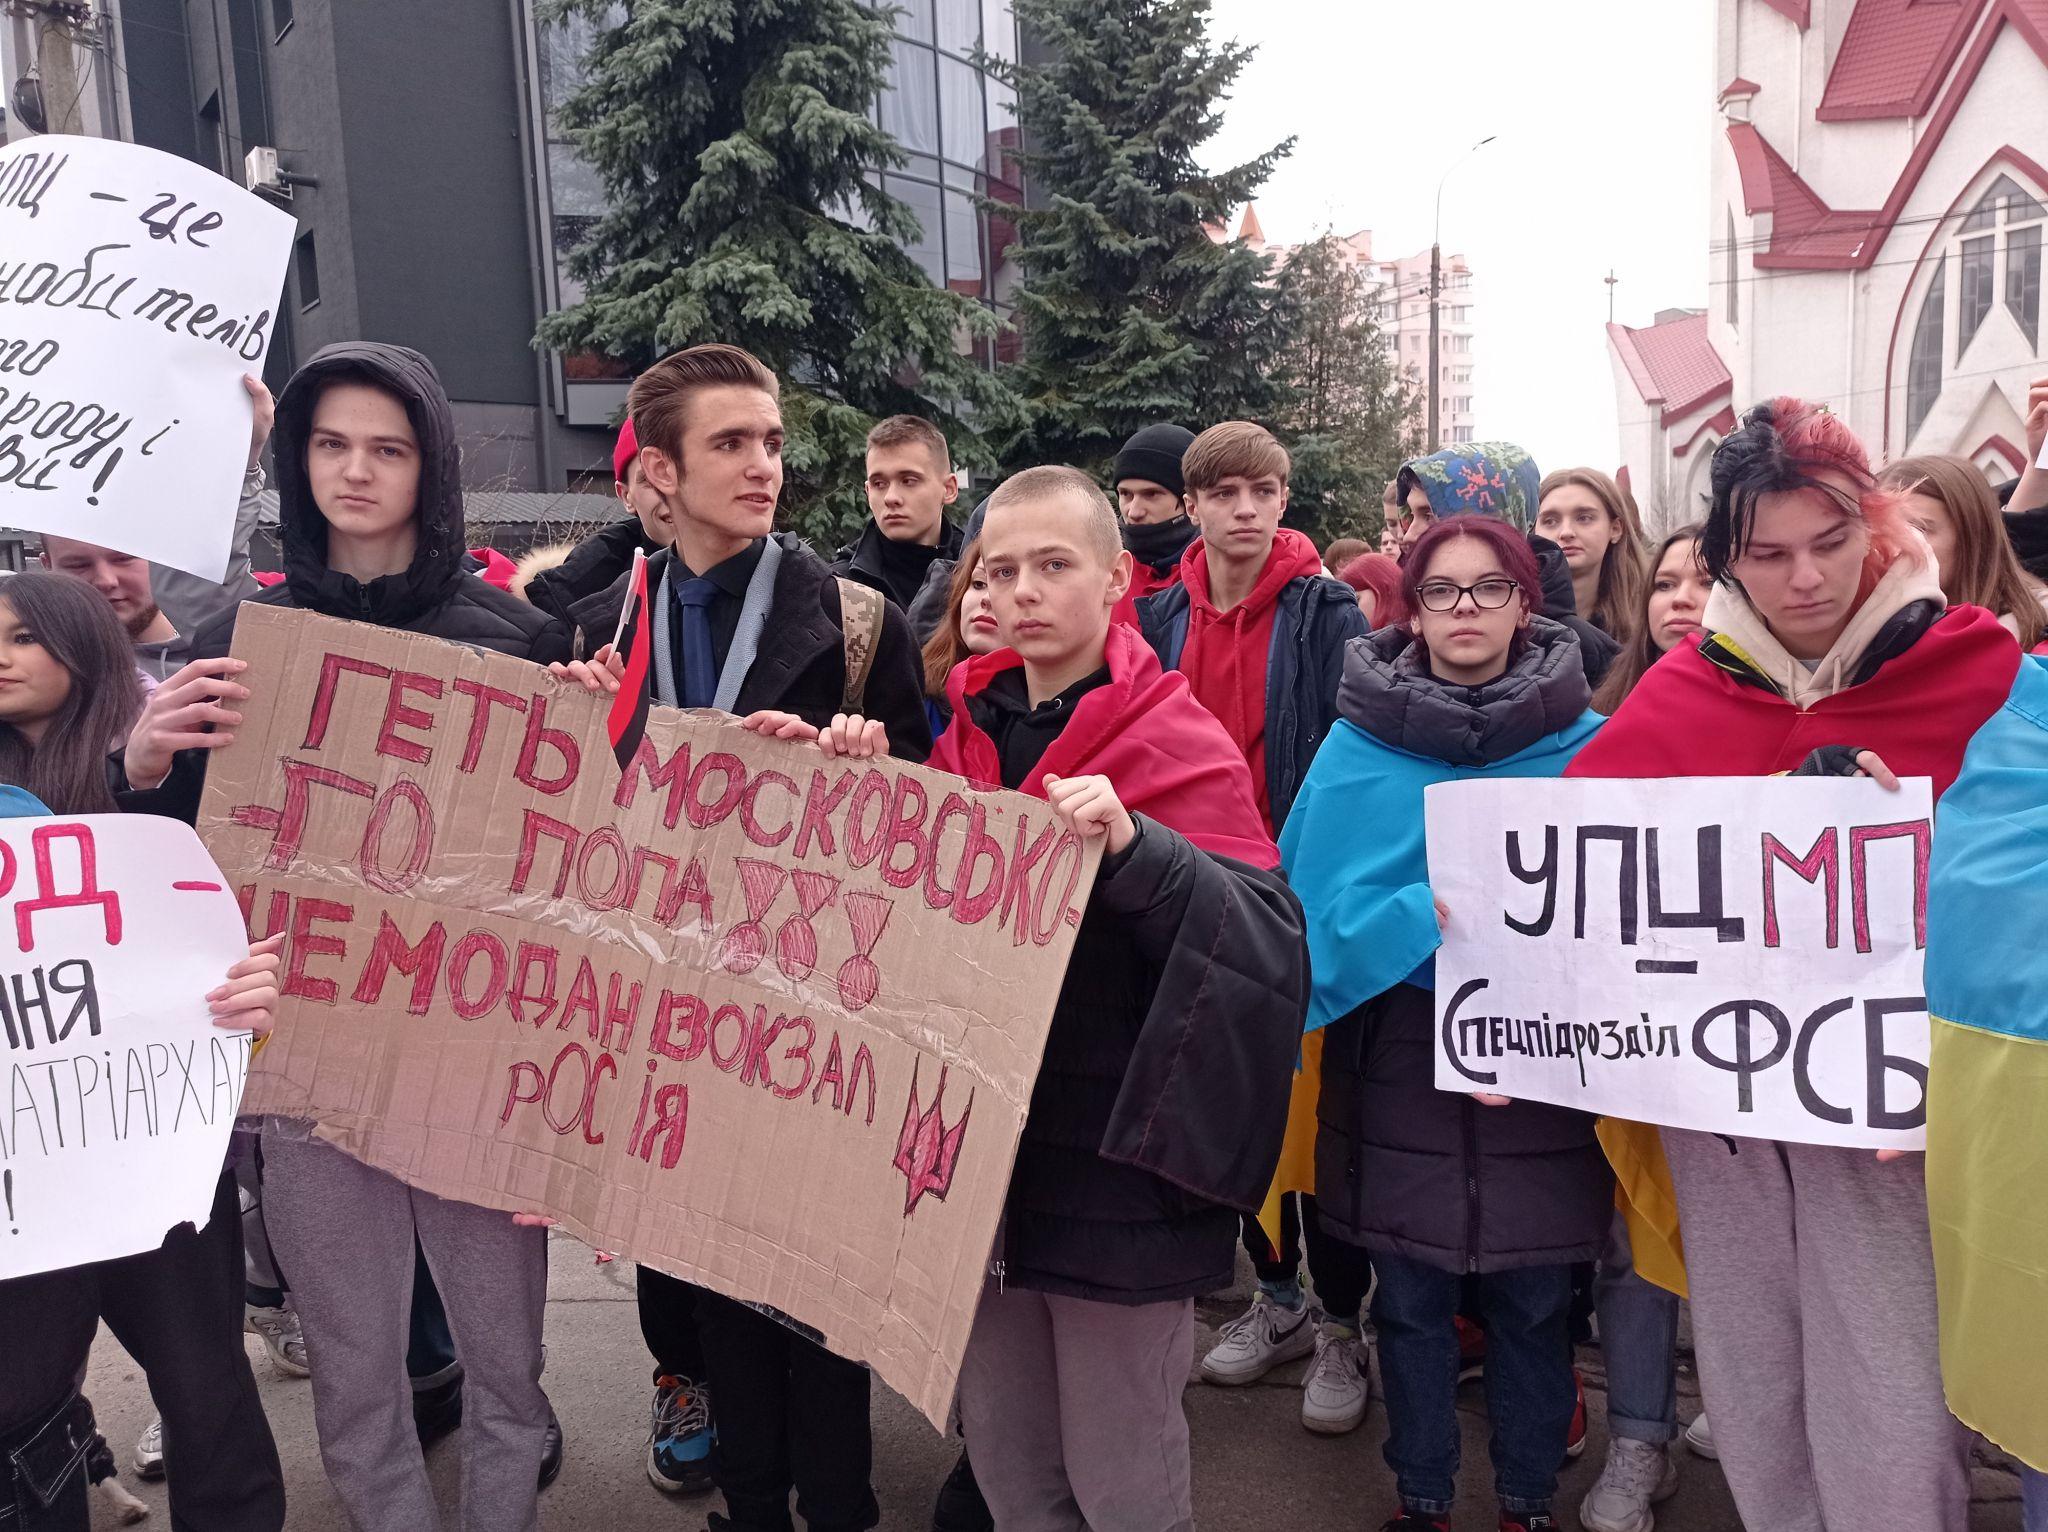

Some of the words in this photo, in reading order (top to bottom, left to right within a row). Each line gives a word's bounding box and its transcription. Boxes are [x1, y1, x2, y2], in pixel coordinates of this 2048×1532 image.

[138, 193, 223, 247] це
[0, 338, 60, 376] го
[0, 386, 134, 469] роду
[300, 652, 581, 797] ГЕТЬ
[1503, 824, 1745, 946] УПЦ
[1761, 818, 1931, 954] МП
[237, 882, 643, 1054] ЧЕМОДАН
[649, 988, 877, 1127] ВОКЗАЛ
[1691, 995, 1929, 1130] ФСБ
